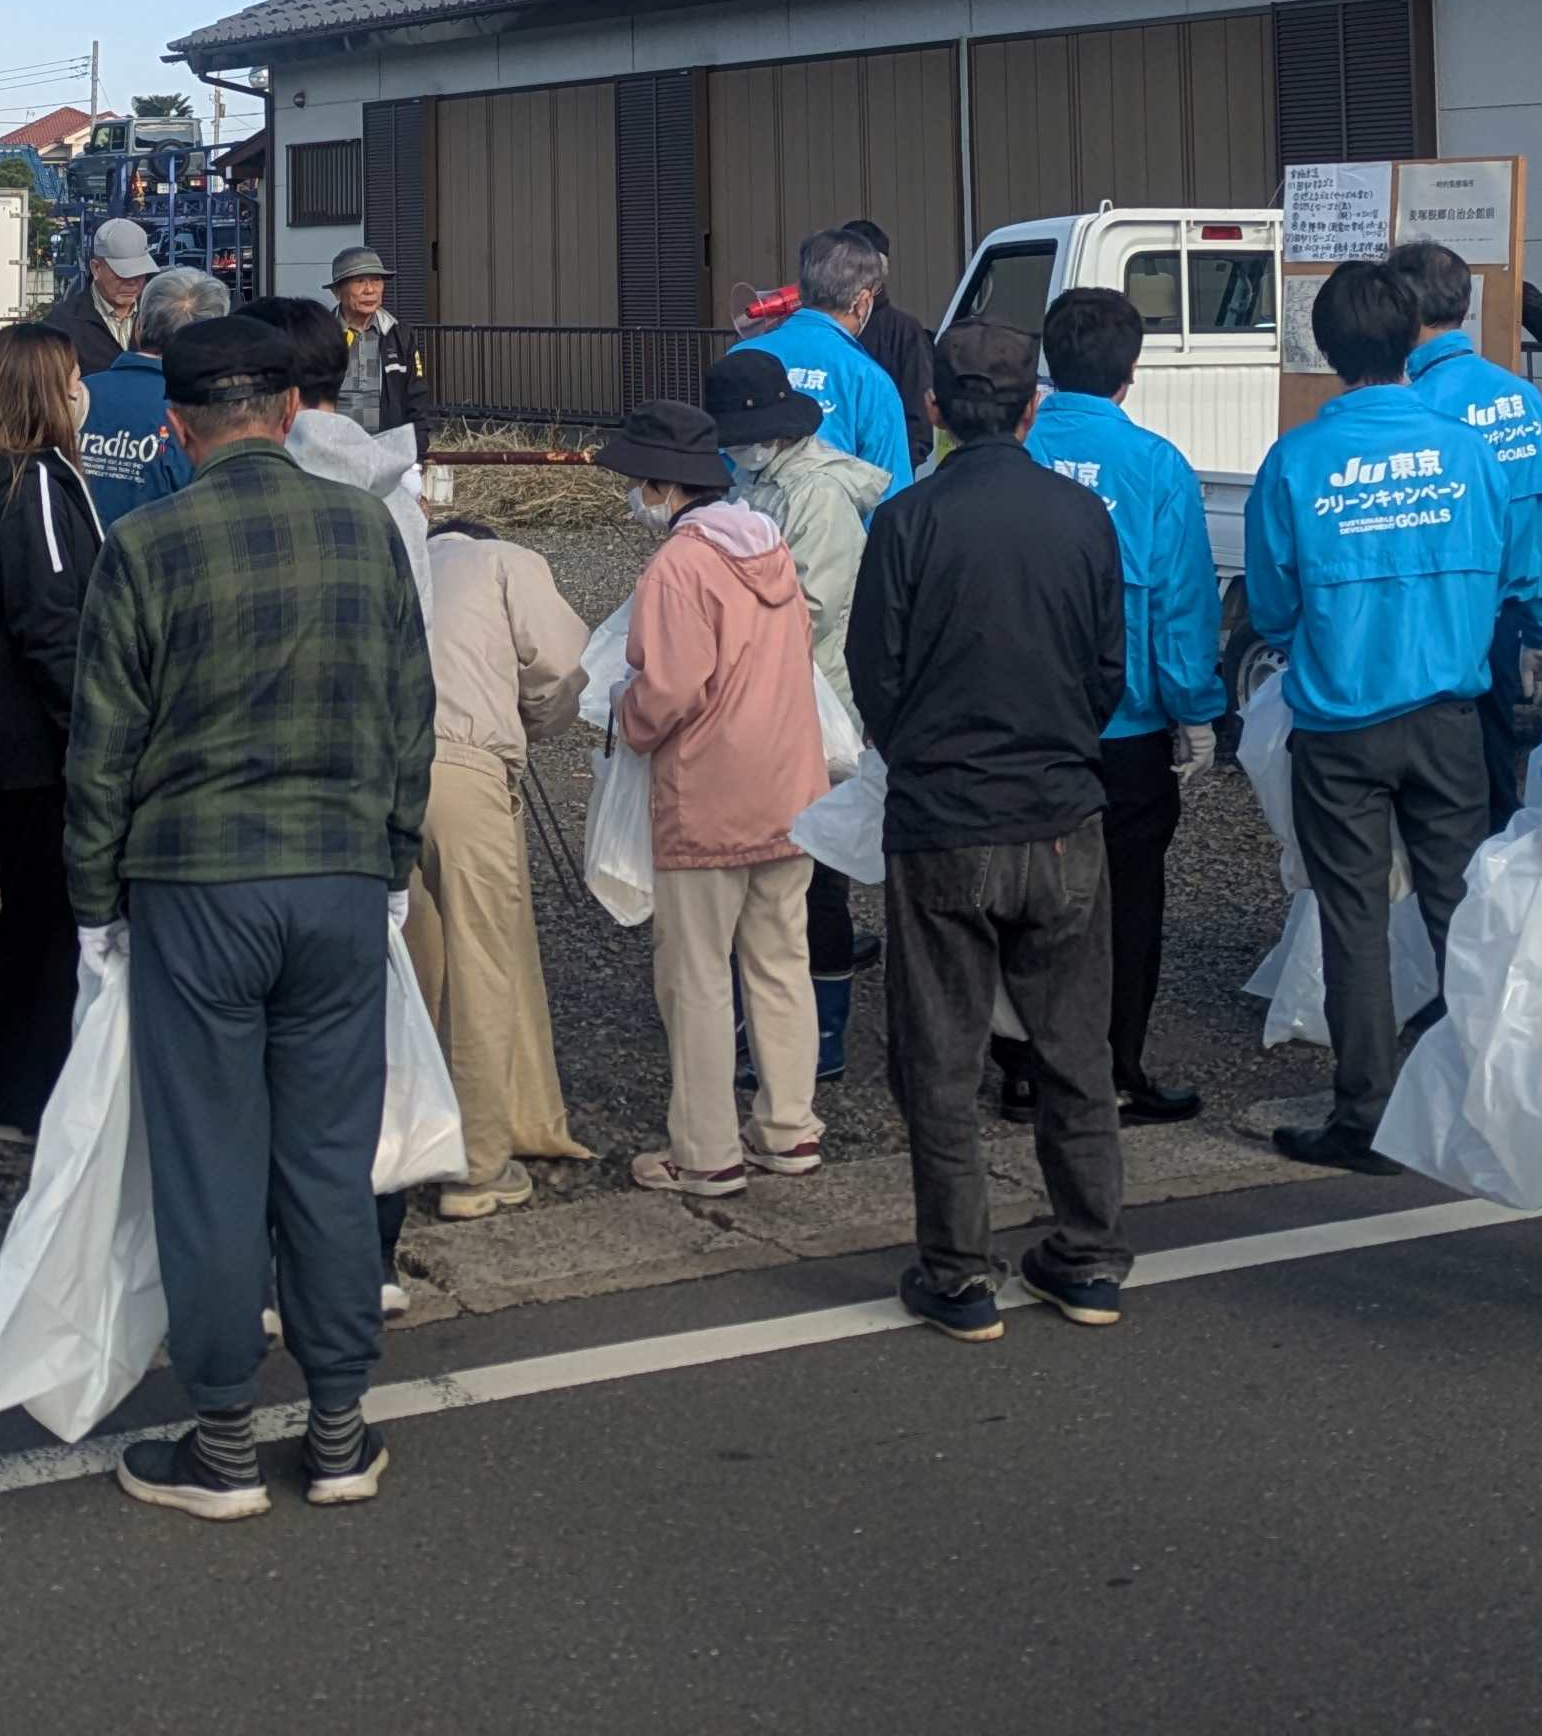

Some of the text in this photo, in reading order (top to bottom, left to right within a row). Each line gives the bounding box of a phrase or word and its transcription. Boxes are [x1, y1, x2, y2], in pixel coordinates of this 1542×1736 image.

[787, 368, 828, 391] 東京
[1497, 444, 1537, 462] GOALS
[1314, 481, 1466, 516] クリーンキャンペーン
[1395, 508, 1452, 528] GOALS
